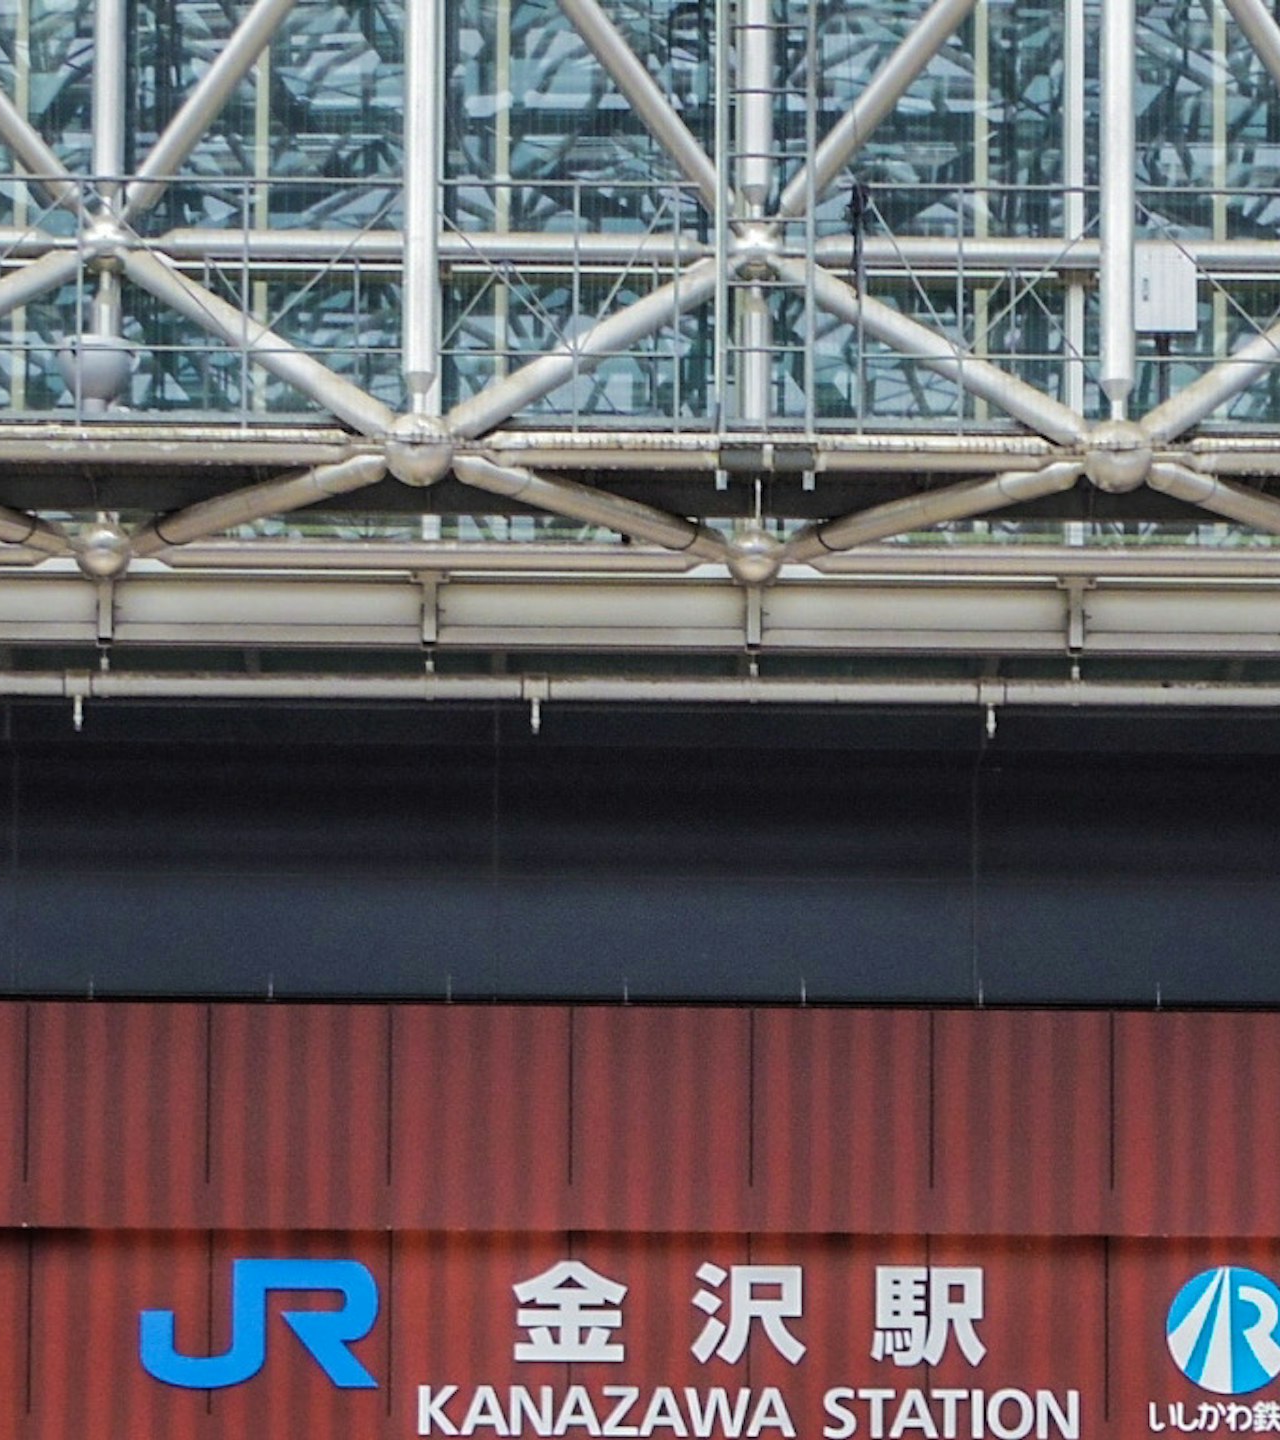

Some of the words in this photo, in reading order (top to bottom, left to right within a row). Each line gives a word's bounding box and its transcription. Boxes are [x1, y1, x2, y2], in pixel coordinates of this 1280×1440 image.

[139, 1257, 380, 1389] JR
[512, 1260, 988, 1366] 金沢駅
[417, 1384, 797, 1439] KANAZAWA
[822, 1386, 1081, 1440] STATION
